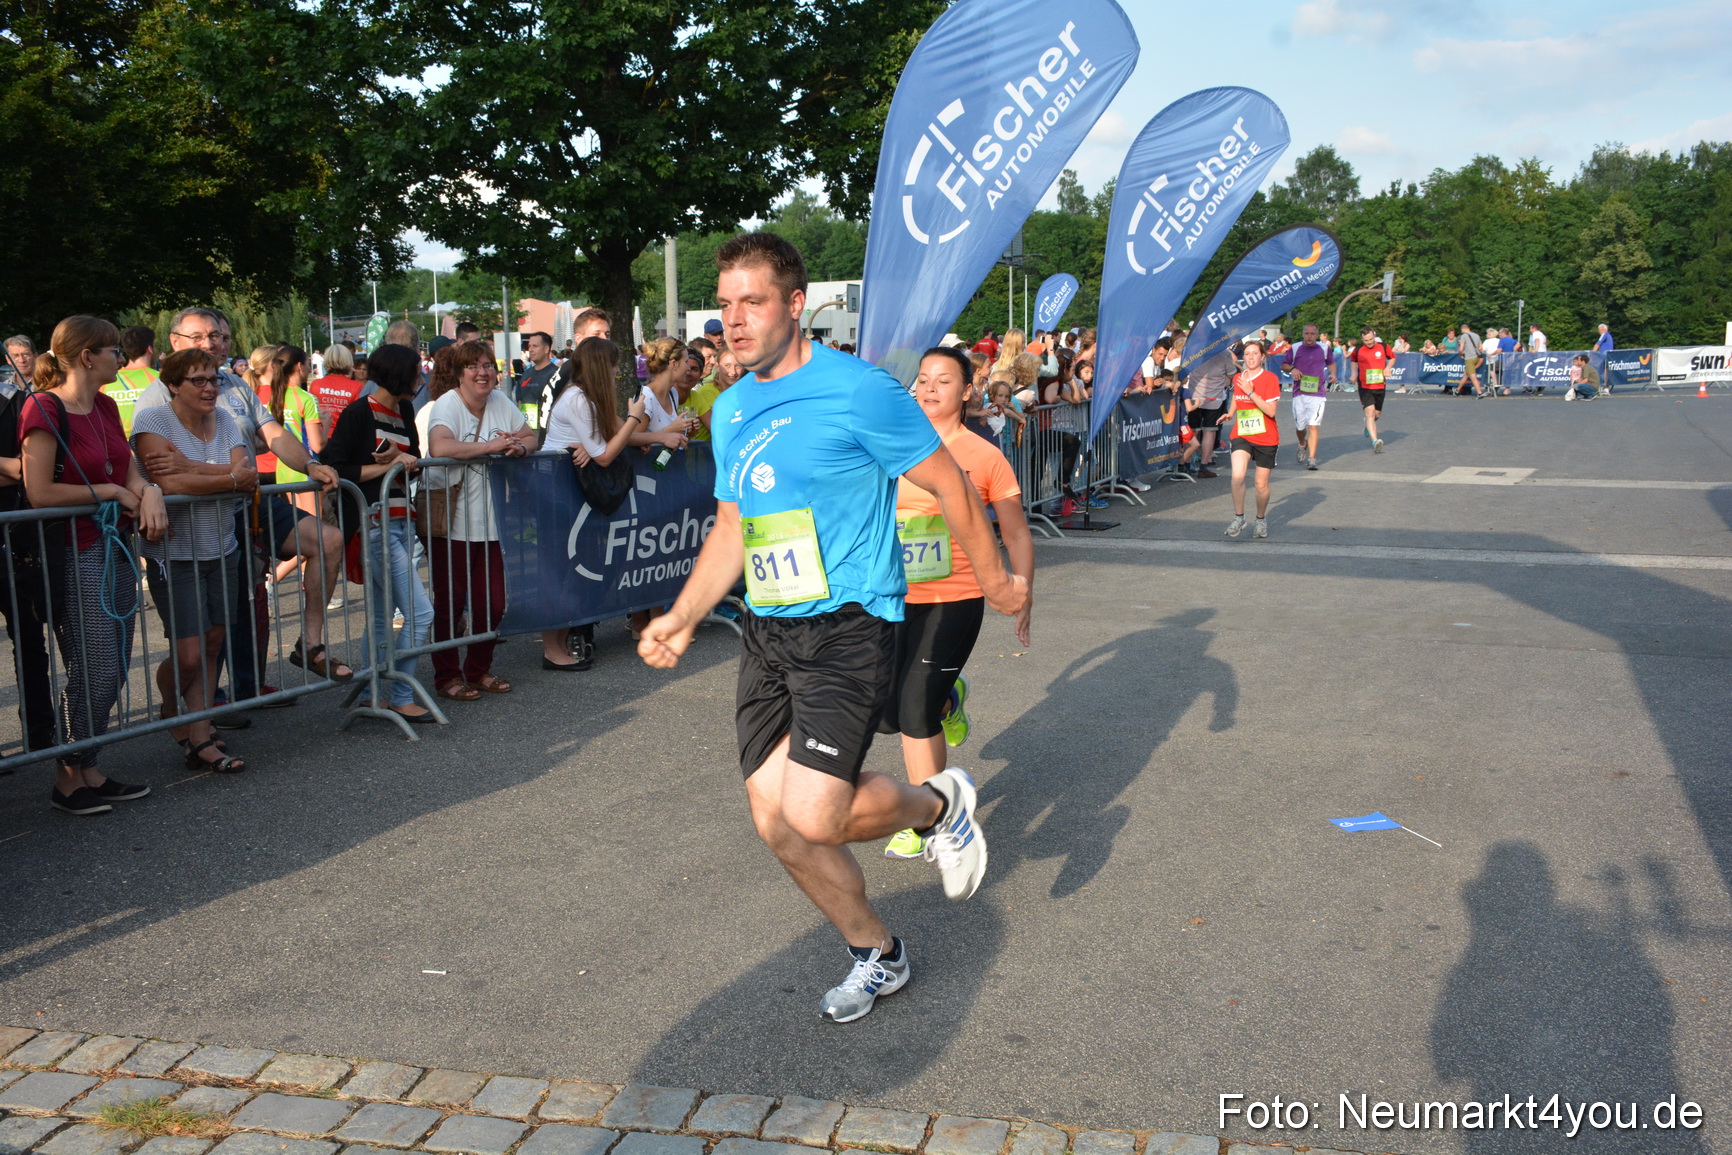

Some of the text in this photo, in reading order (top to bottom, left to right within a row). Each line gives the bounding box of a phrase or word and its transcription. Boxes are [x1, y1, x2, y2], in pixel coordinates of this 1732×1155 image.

[936, 20, 1081, 213] Fischer
[985, 58, 1097, 211] AUTOMOBILE
[1150, 116, 1249, 252] Fischer
[1185, 141, 1262, 250] AUTOMOBILE
[1044, 281, 1069, 317] Fischer
[1207, 269, 1303, 329] Frischmann
[1269, 288, 1292, 304] Druck
[1306, 262, 1335, 283] Medien
[1535, 365, 1571, 376] Fisch
[1608, 360, 1640, 371] Frischmann
[320, 387, 352, 397] Miele
[322, 397, 349, 405] CENTER
[739, 428, 770, 459] Schick
[771, 417, 792, 430] Bau
[1240, 418, 1261, 428] 1471
[604, 508, 717, 566] Fische
[902, 541, 942, 564] 571
[617, 556, 699, 591] AUTOMO
[751, 549, 800, 581] 811
